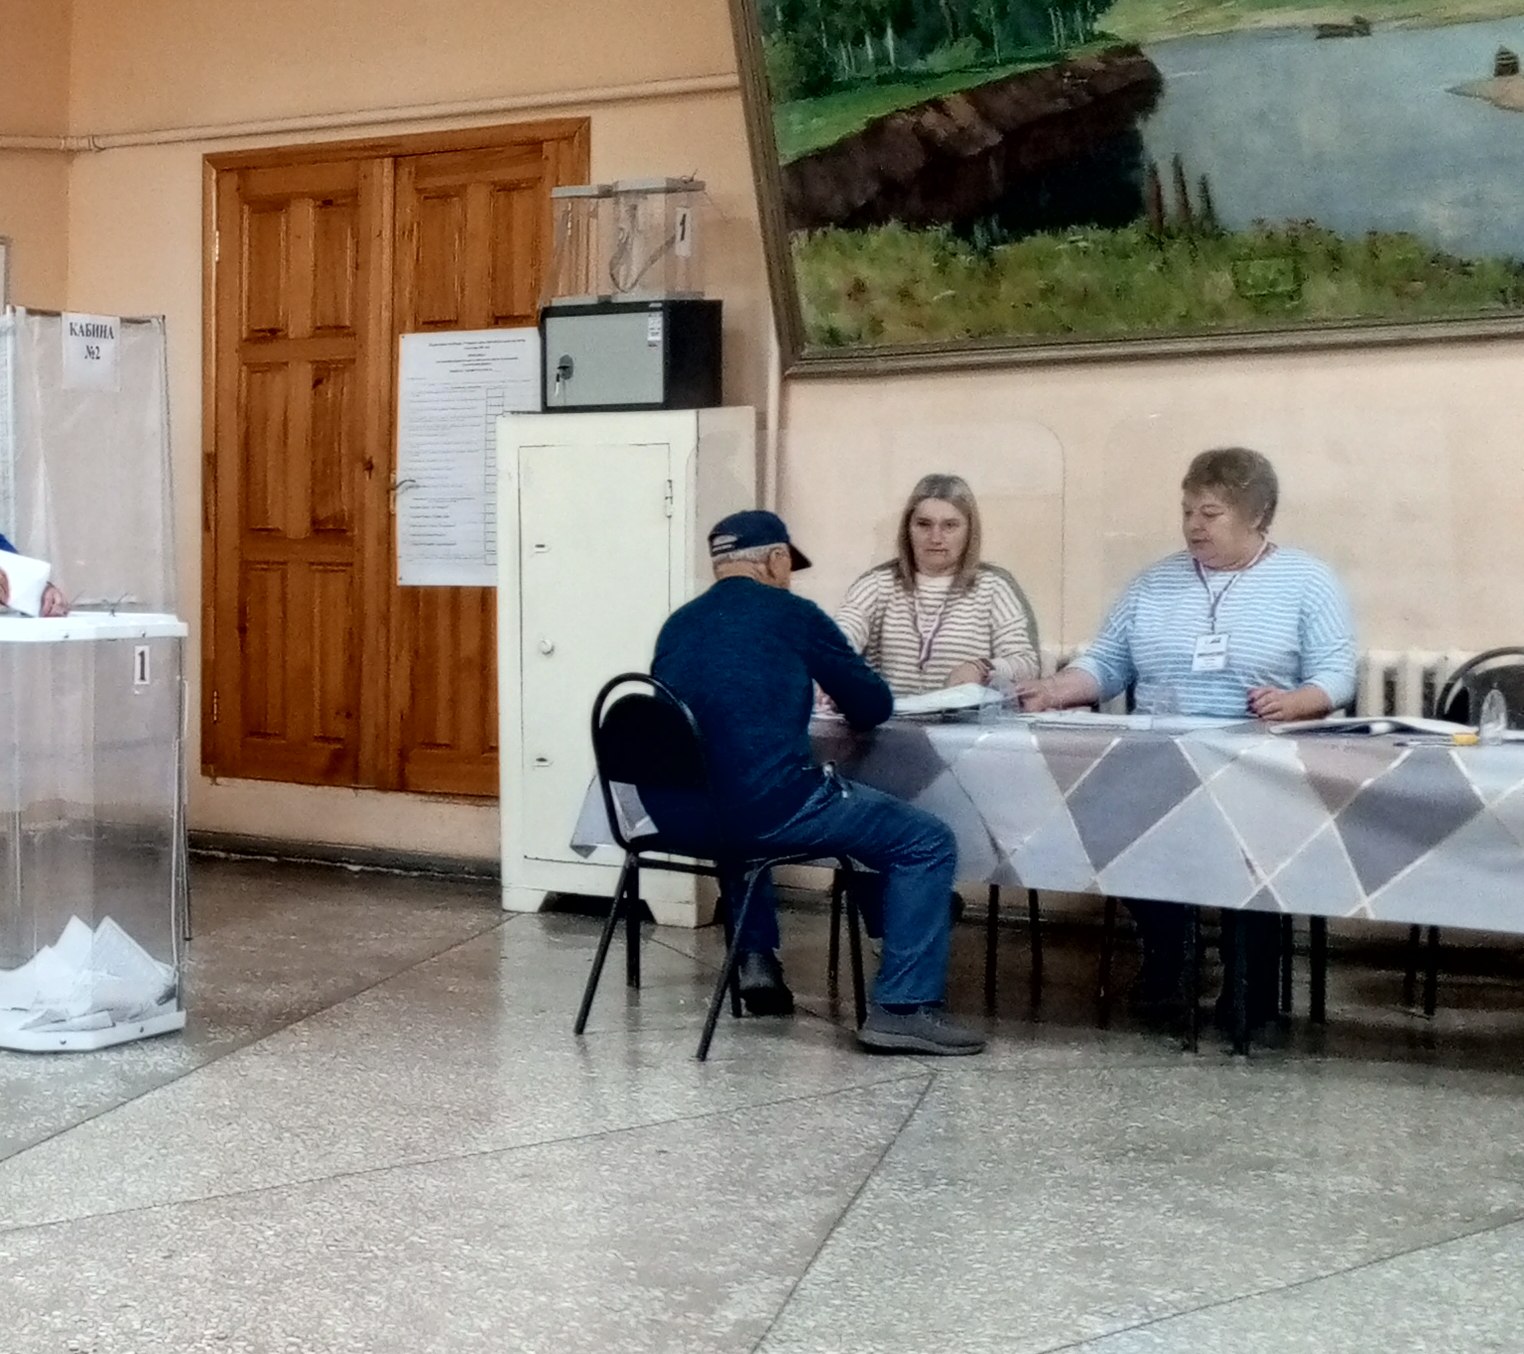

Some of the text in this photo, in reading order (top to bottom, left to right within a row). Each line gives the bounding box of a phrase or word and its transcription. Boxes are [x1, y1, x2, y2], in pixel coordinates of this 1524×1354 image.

[679, 213, 687, 242] 1
[69, 321, 115, 340] КАБИНА
[84, 344, 101, 360] №2
[138, 649, 147, 682] 1
